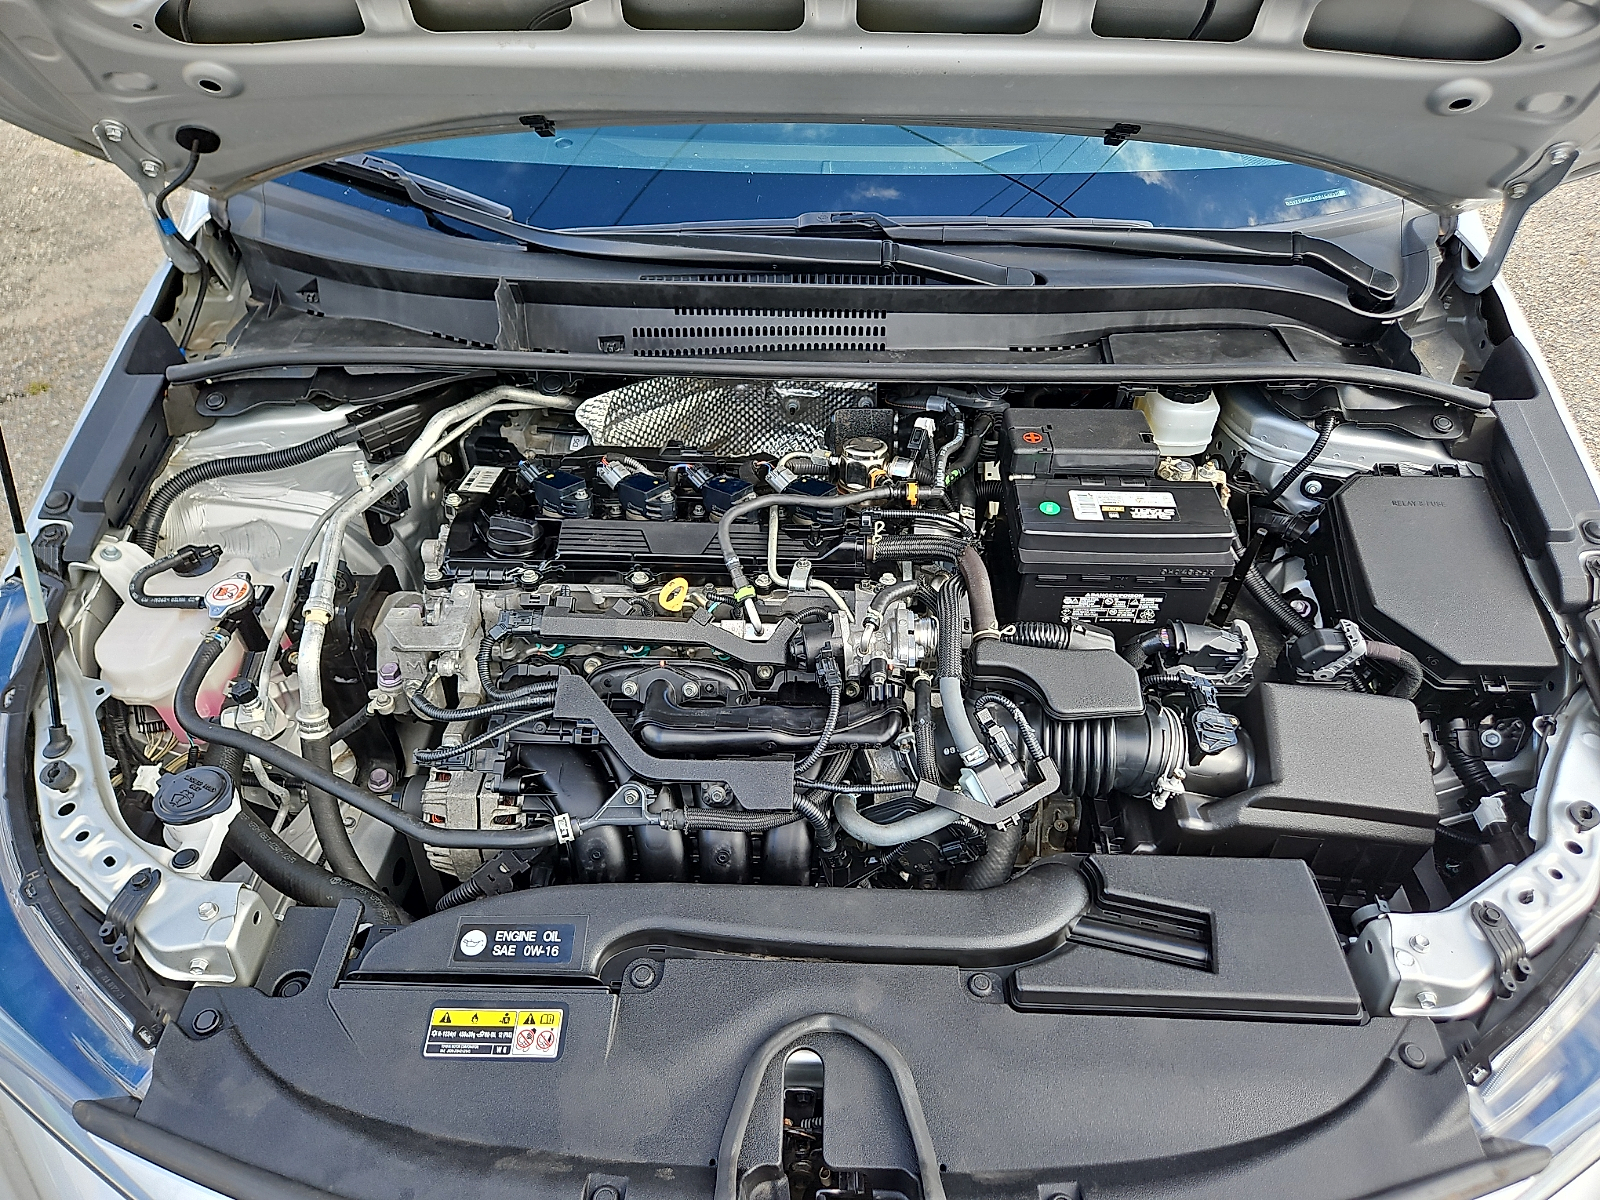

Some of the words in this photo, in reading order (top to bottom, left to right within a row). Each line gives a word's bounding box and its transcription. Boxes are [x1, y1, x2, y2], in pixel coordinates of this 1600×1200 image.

[495, 930, 537, 942] ENGINE
[543, 930, 561, 942] OIL
[492, 944, 517, 956] SAE
[523, 944, 560, 957] 0W-16
